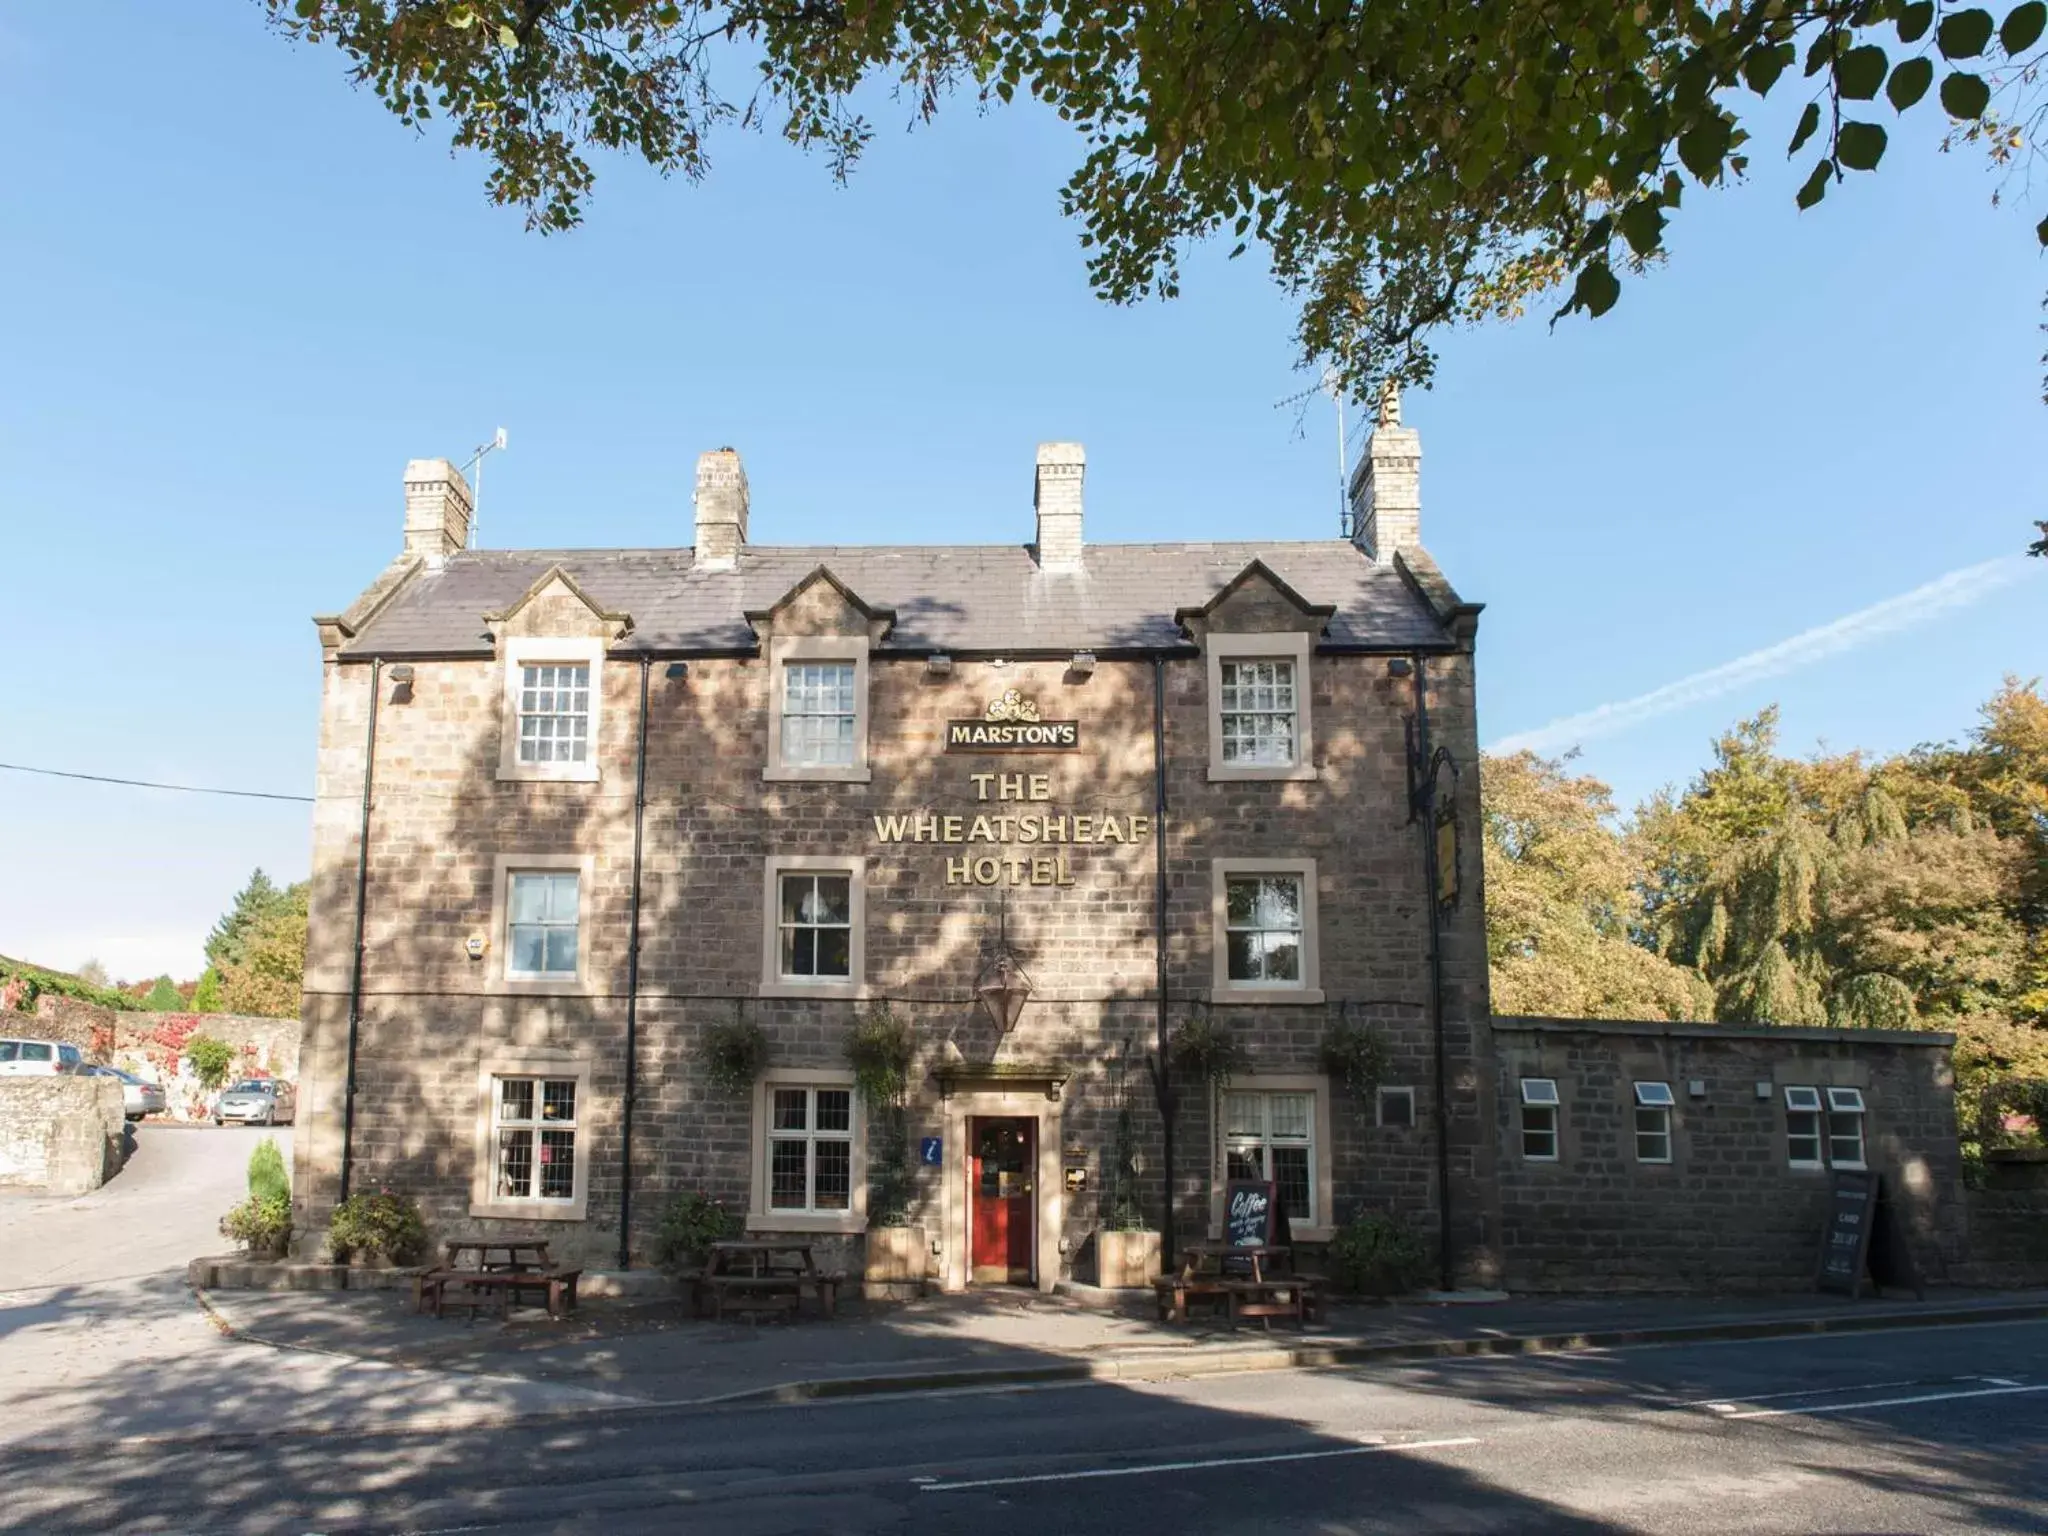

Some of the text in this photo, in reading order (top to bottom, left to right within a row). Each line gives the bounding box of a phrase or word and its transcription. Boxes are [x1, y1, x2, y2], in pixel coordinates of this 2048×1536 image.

[951, 725, 1075, 744] MARSTON'S
[970, 773, 1050, 801] THE
[873, 815, 1149, 844] WHEATSHEAF
[945, 856, 1076, 886] HOTEL
